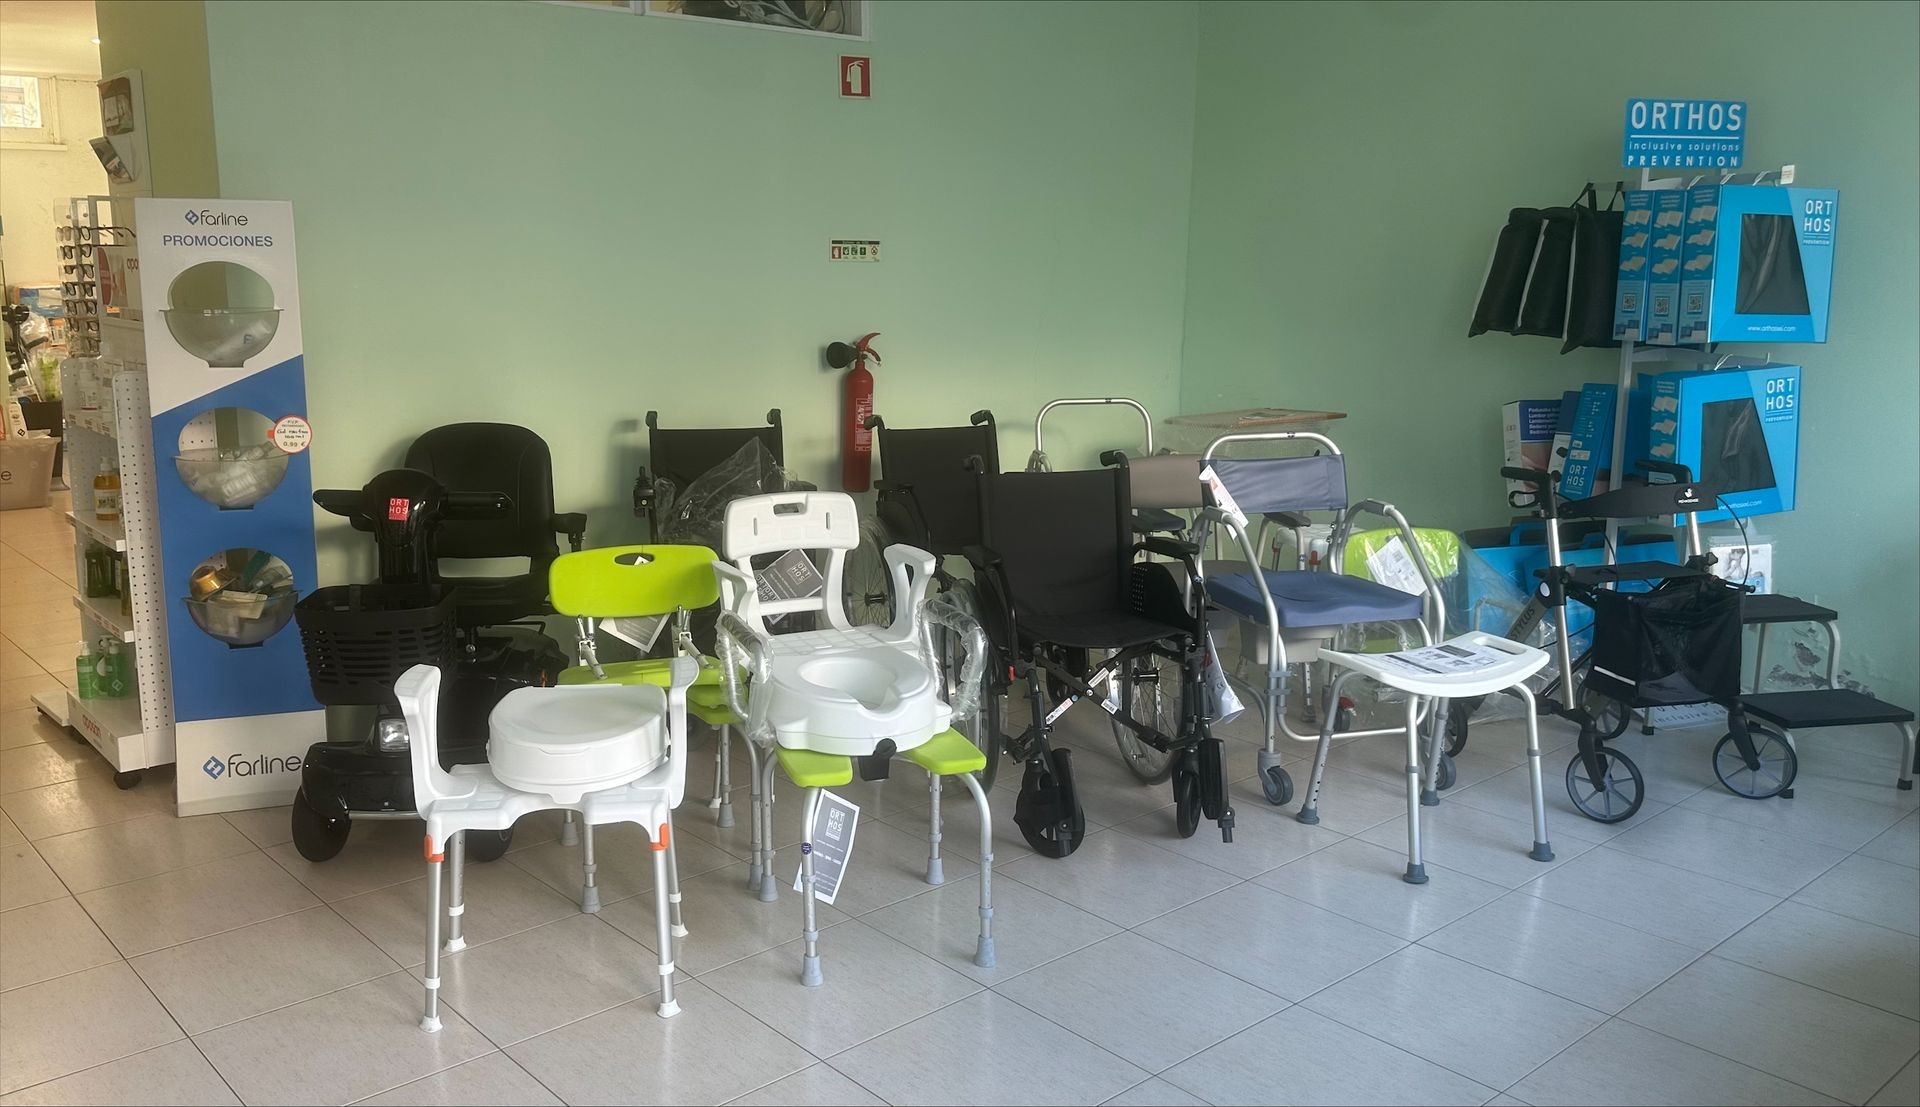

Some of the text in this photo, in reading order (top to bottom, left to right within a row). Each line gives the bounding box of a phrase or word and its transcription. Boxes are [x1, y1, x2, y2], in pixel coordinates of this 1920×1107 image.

[1631, 101, 1742, 131] ORTHOS
[1629, 141, 1740, 152] inclusive solutions
[1627, 155, 1738, 167] PREVENTION
[1805, 200, 1833, 215] ORT
[200, 209, 248, 226] farline
[1803, 218, 1831, 232] HOS
[163, 235, 273, 247] PROMOCIONES
[1767, 378, 1795, 394] ORT
[1766, 395, 1793, 410] HOS
[1568, 464, 1588, 476] ORT
[1566, 475, 1585, 487] HOS
[390, 498, 409, 507] ORT
[389, 506, 408, 515] HOS
[1510, 608, 1535, 640] STYLUS
[227, 753, 301, 778] farline
